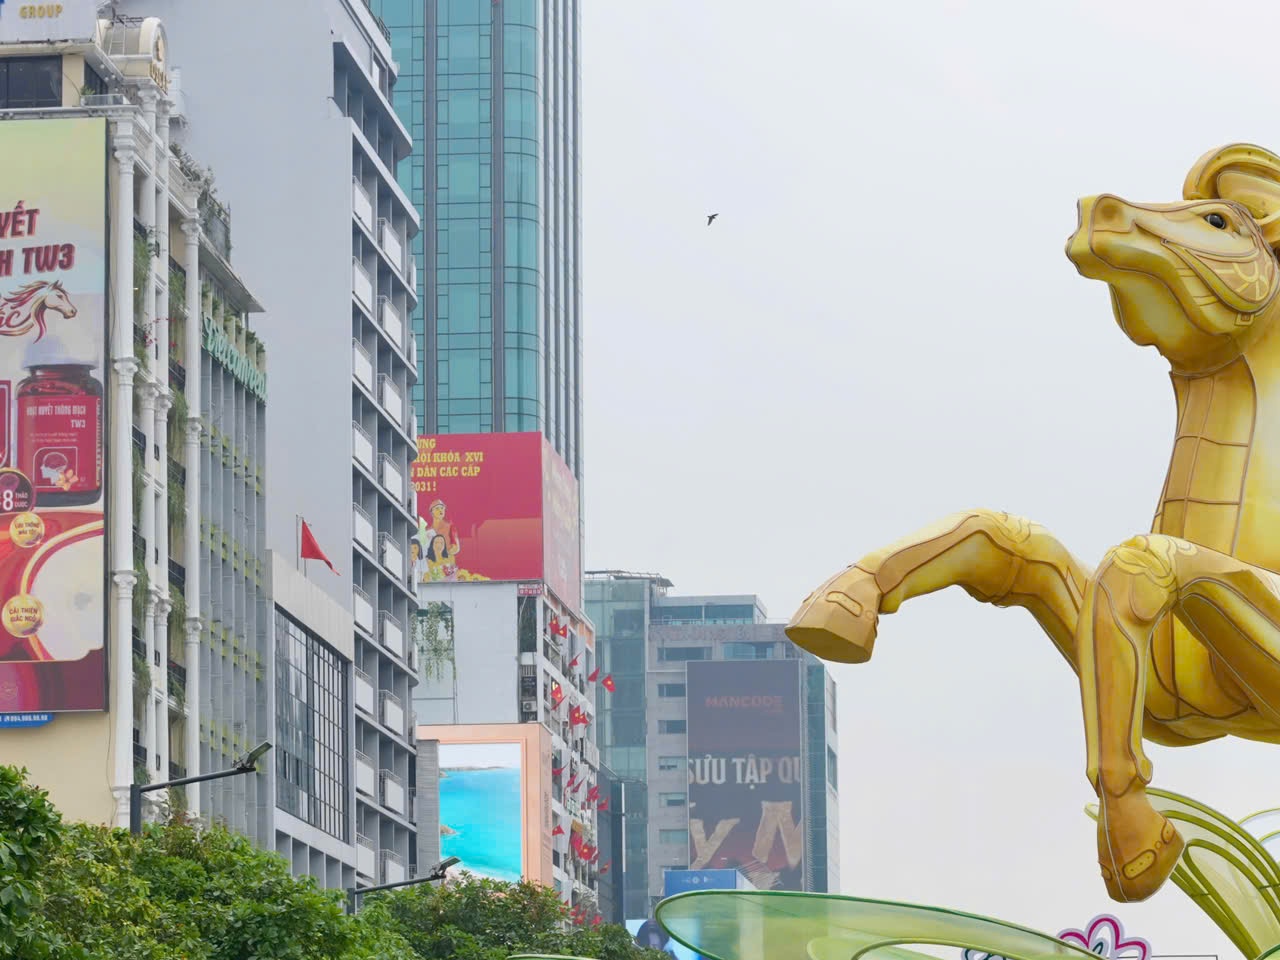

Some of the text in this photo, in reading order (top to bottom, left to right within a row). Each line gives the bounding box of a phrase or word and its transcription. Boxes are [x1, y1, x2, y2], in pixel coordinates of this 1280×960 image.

[19, 4, 64, 19] GROUP
[22, 243, 76, 274] TW3
[71, 418, 87, 429] TW3
[465, 451, 484, 463] XVI
[3, 490, 14, 511] 8
[732, 754, 773, 791] TẬP
